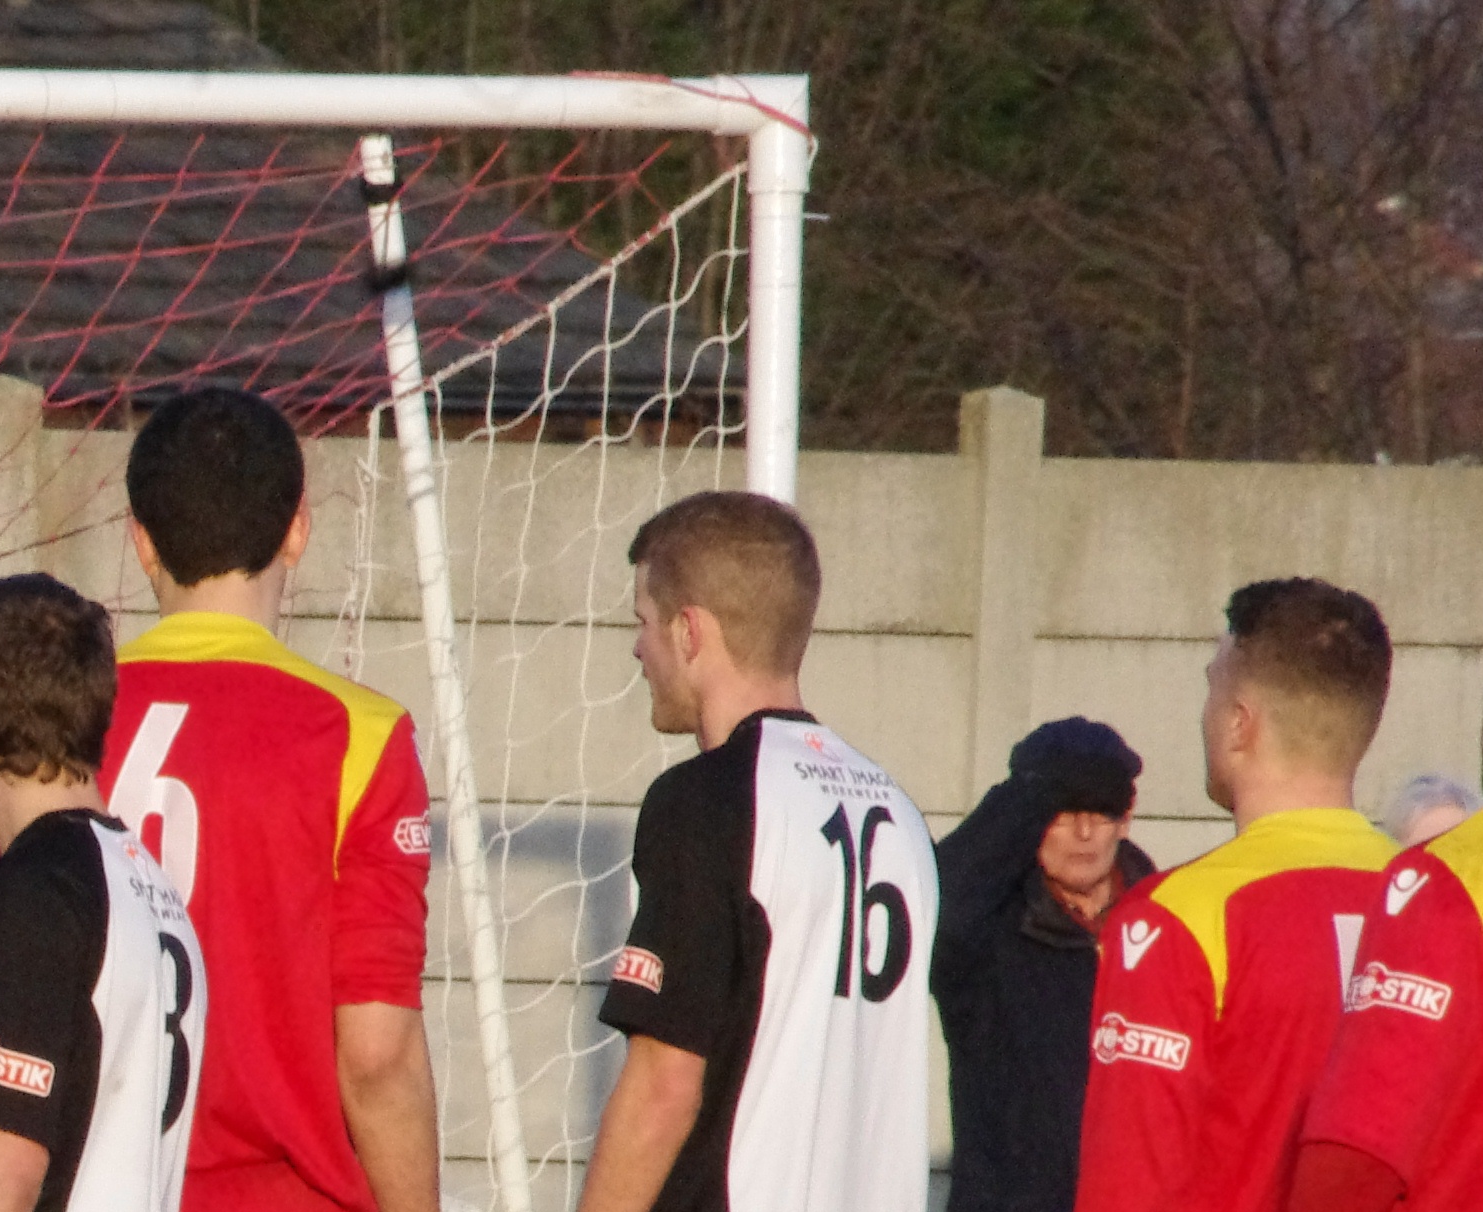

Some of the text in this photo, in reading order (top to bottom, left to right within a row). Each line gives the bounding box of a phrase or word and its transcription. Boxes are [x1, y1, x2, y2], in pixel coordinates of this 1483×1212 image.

[108, 702, 199, 908] 6
[794, 761, 846, 783] SMART
[614, 952, 662, 989] STIK
[820, 801, 913, 1003] 16
[159, 932, 193, 1137] 3
